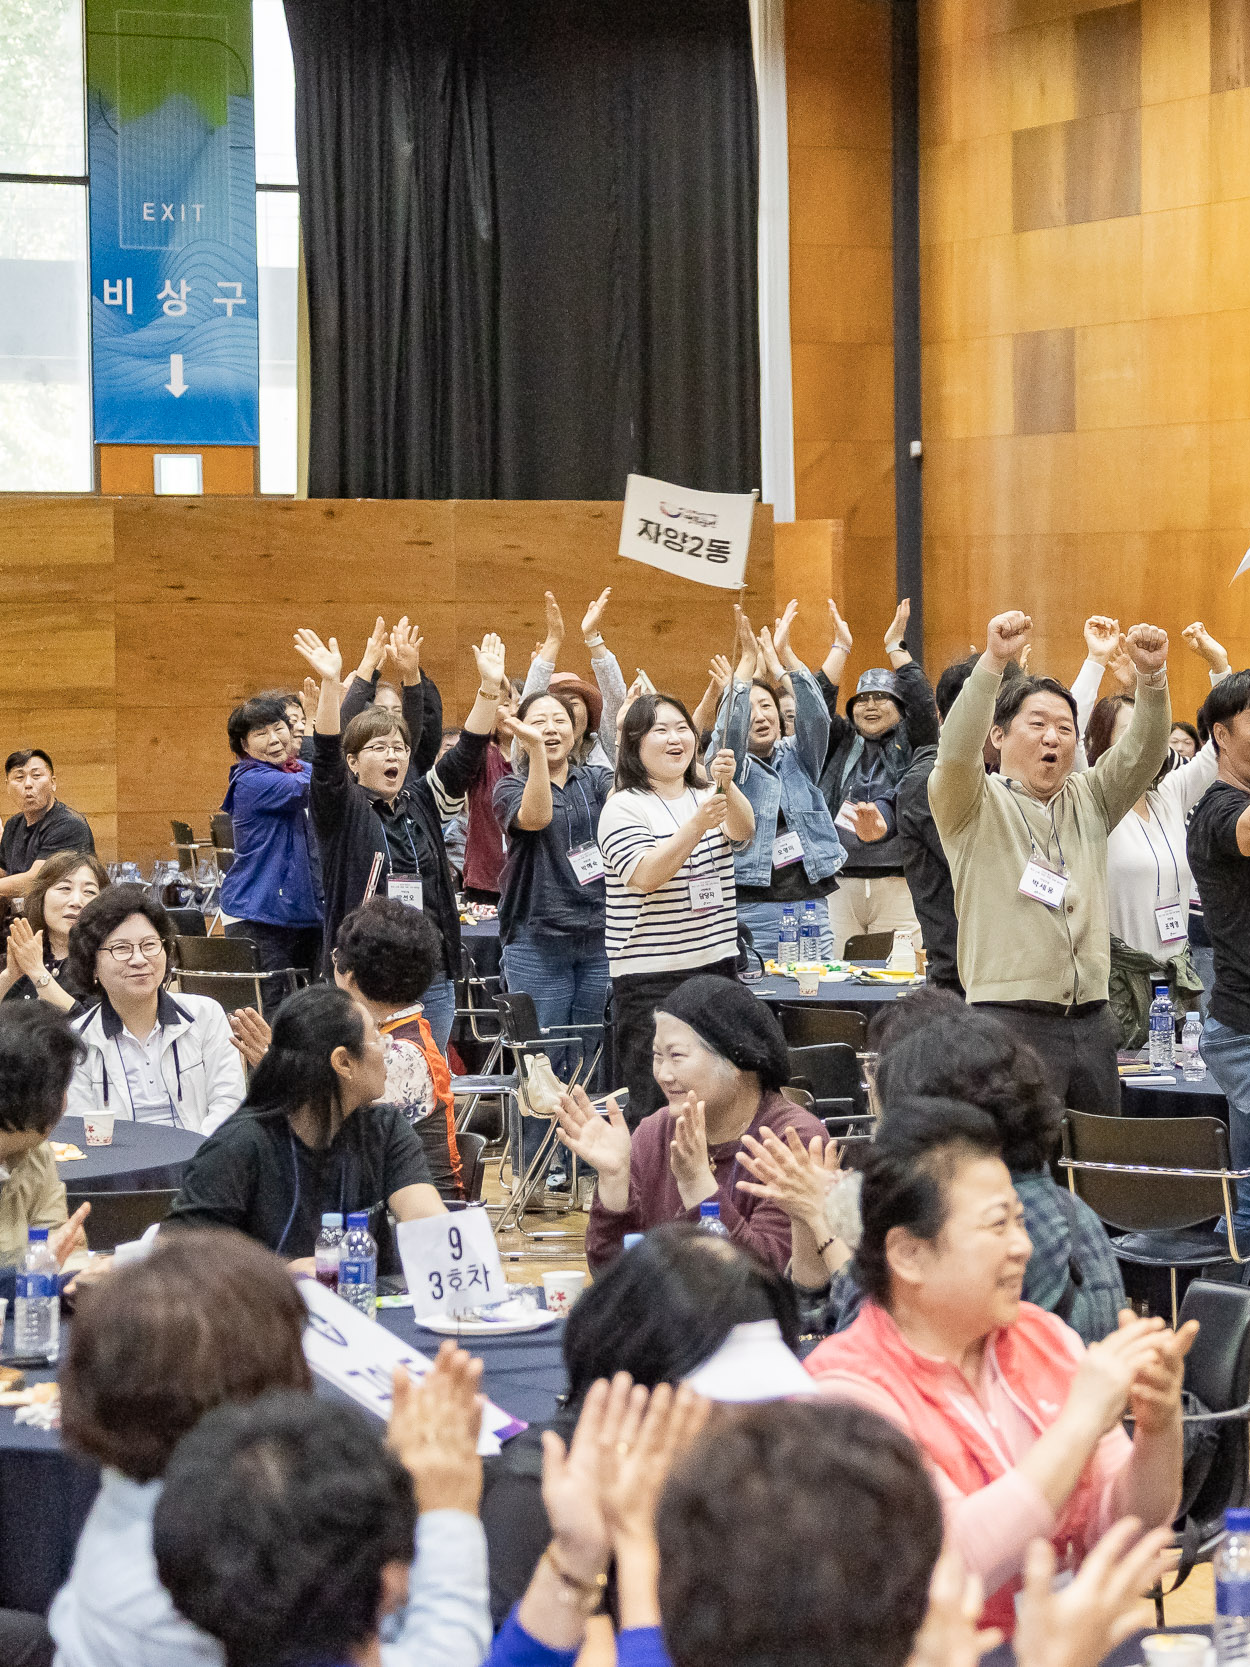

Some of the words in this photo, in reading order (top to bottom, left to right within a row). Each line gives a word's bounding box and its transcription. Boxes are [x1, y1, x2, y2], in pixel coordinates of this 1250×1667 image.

[143, 202, 205, 223] EXIT
[103, 277, 247, 317] 비상구
[637, 518, 732, 564] 자양2동
[448, 1226, 463, 1260] 9
[428, 1263, 491, 1300] 3호차
